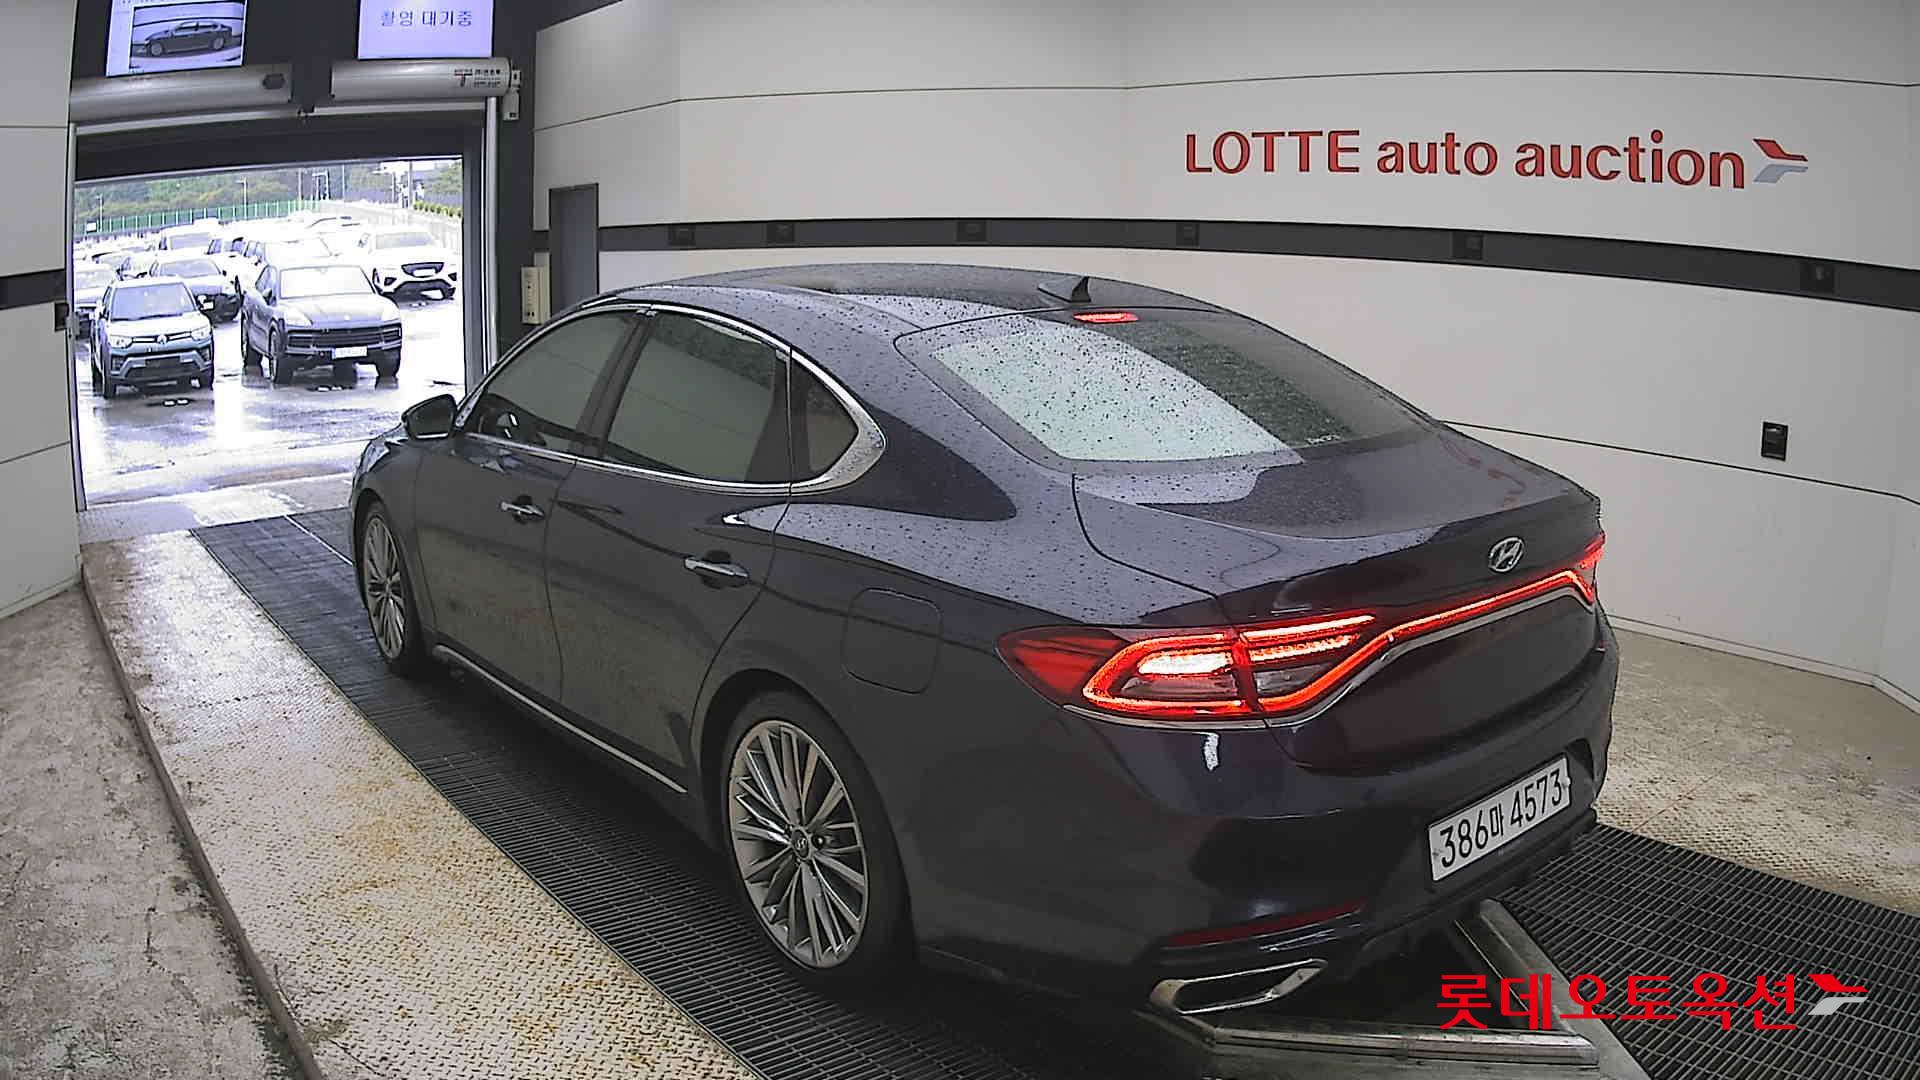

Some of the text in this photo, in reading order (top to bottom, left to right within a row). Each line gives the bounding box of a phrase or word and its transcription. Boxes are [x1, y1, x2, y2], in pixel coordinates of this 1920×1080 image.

[422, 10, 472, 27] 대기중
[1186, 129, 1745, 189] LOTTE auto auction
[1510, 768, 1562, 828] 4573
